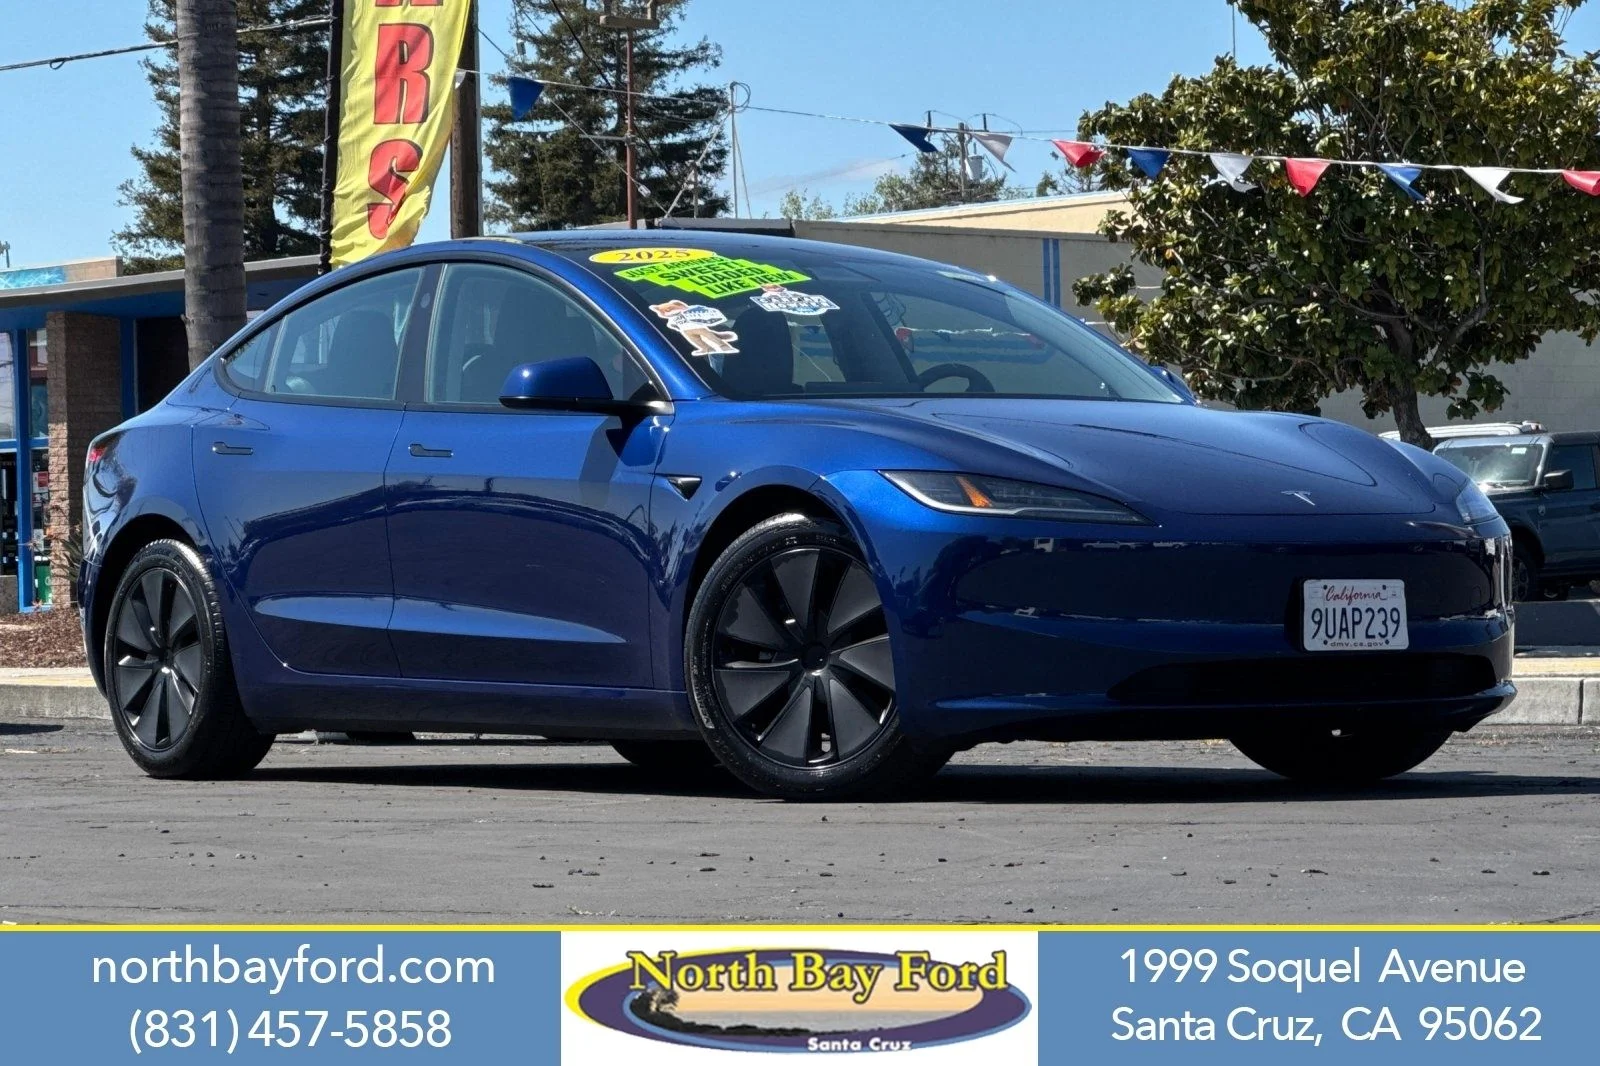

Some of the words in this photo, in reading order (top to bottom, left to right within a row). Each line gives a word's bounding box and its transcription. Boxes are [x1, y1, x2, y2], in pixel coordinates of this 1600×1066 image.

[367, 0, 443, 240] RS
[615, 249, 691, 261] 2025
[625, 265, 661, 278] JUST
[658, 260, 746, 281] SWEET!
[688, 267, 766, 286] LOADED
[705, 279, 751, 295] LIKE
[749, 270, 795, 286] NEW
[1326, 585, 1388, 605] California
[1311, 607, 1400, 640] 9UAP239
